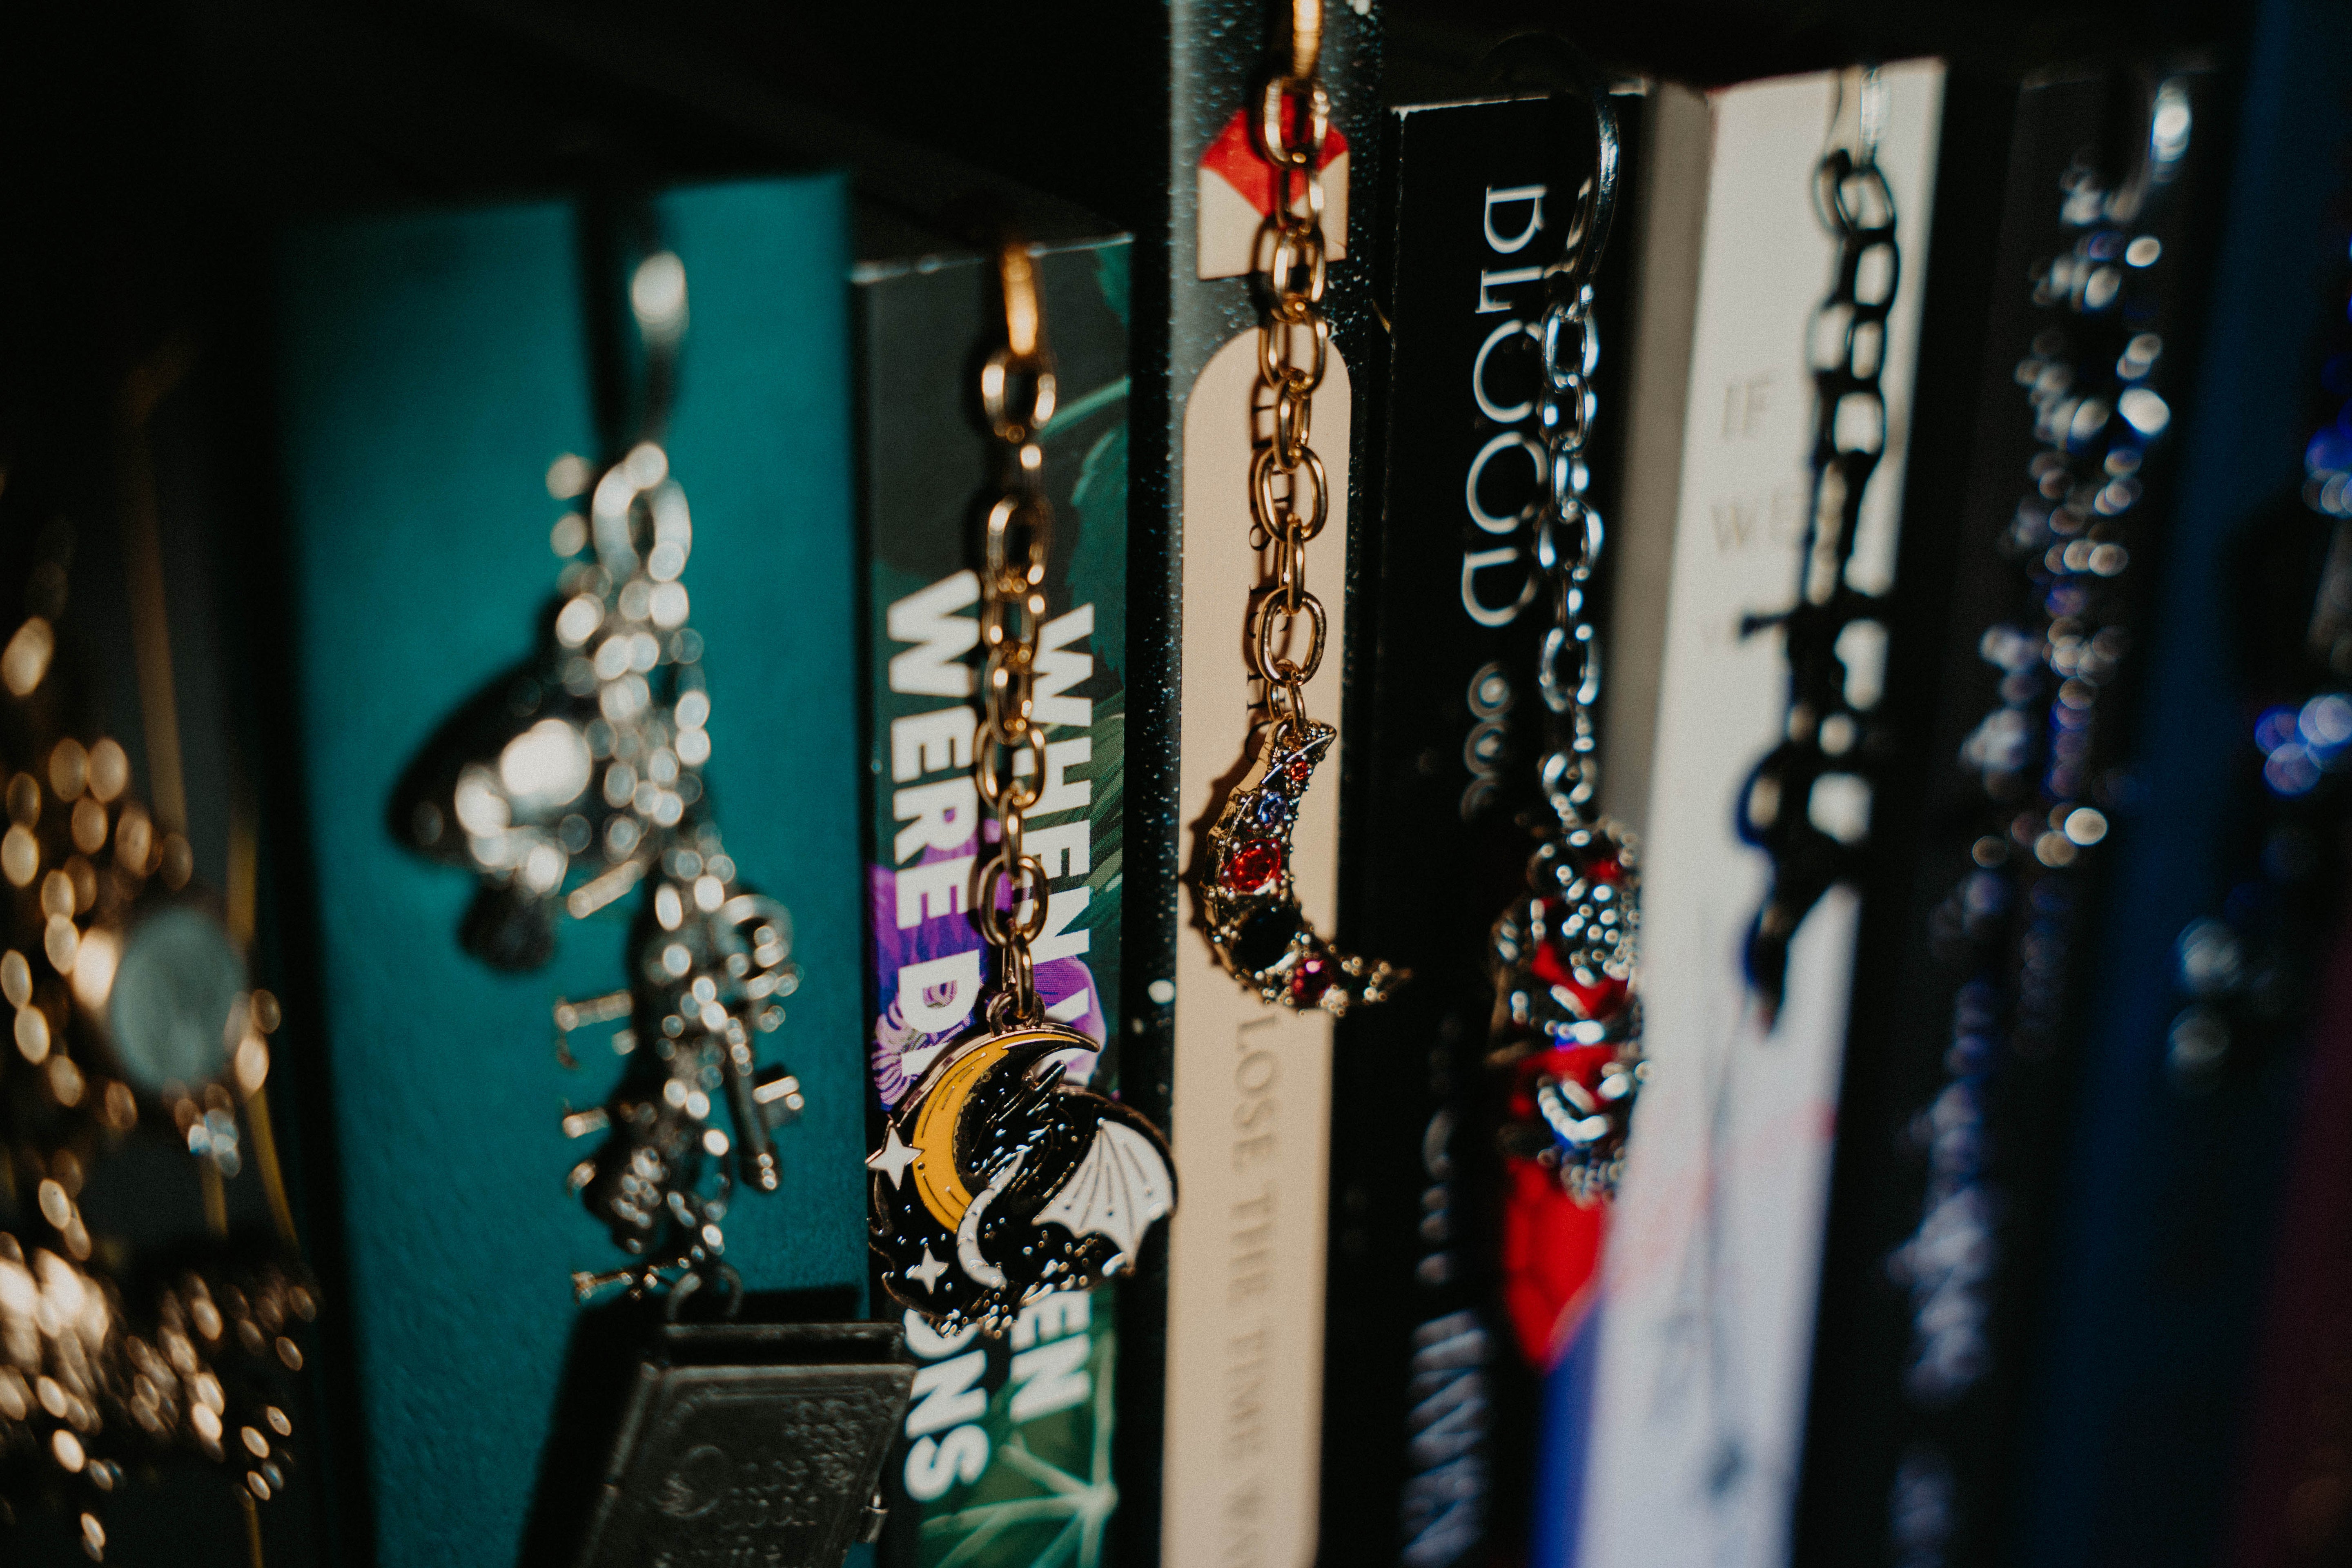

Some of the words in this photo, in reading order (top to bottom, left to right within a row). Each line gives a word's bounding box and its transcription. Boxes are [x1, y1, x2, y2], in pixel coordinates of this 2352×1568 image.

[1461, 184, 1548, 627] BLOOD
[887, 568, 981, 931] WERE
[1011, 602, 1094, 965] WHEN
[1233, 1014, 1278, 1173] LOSE
